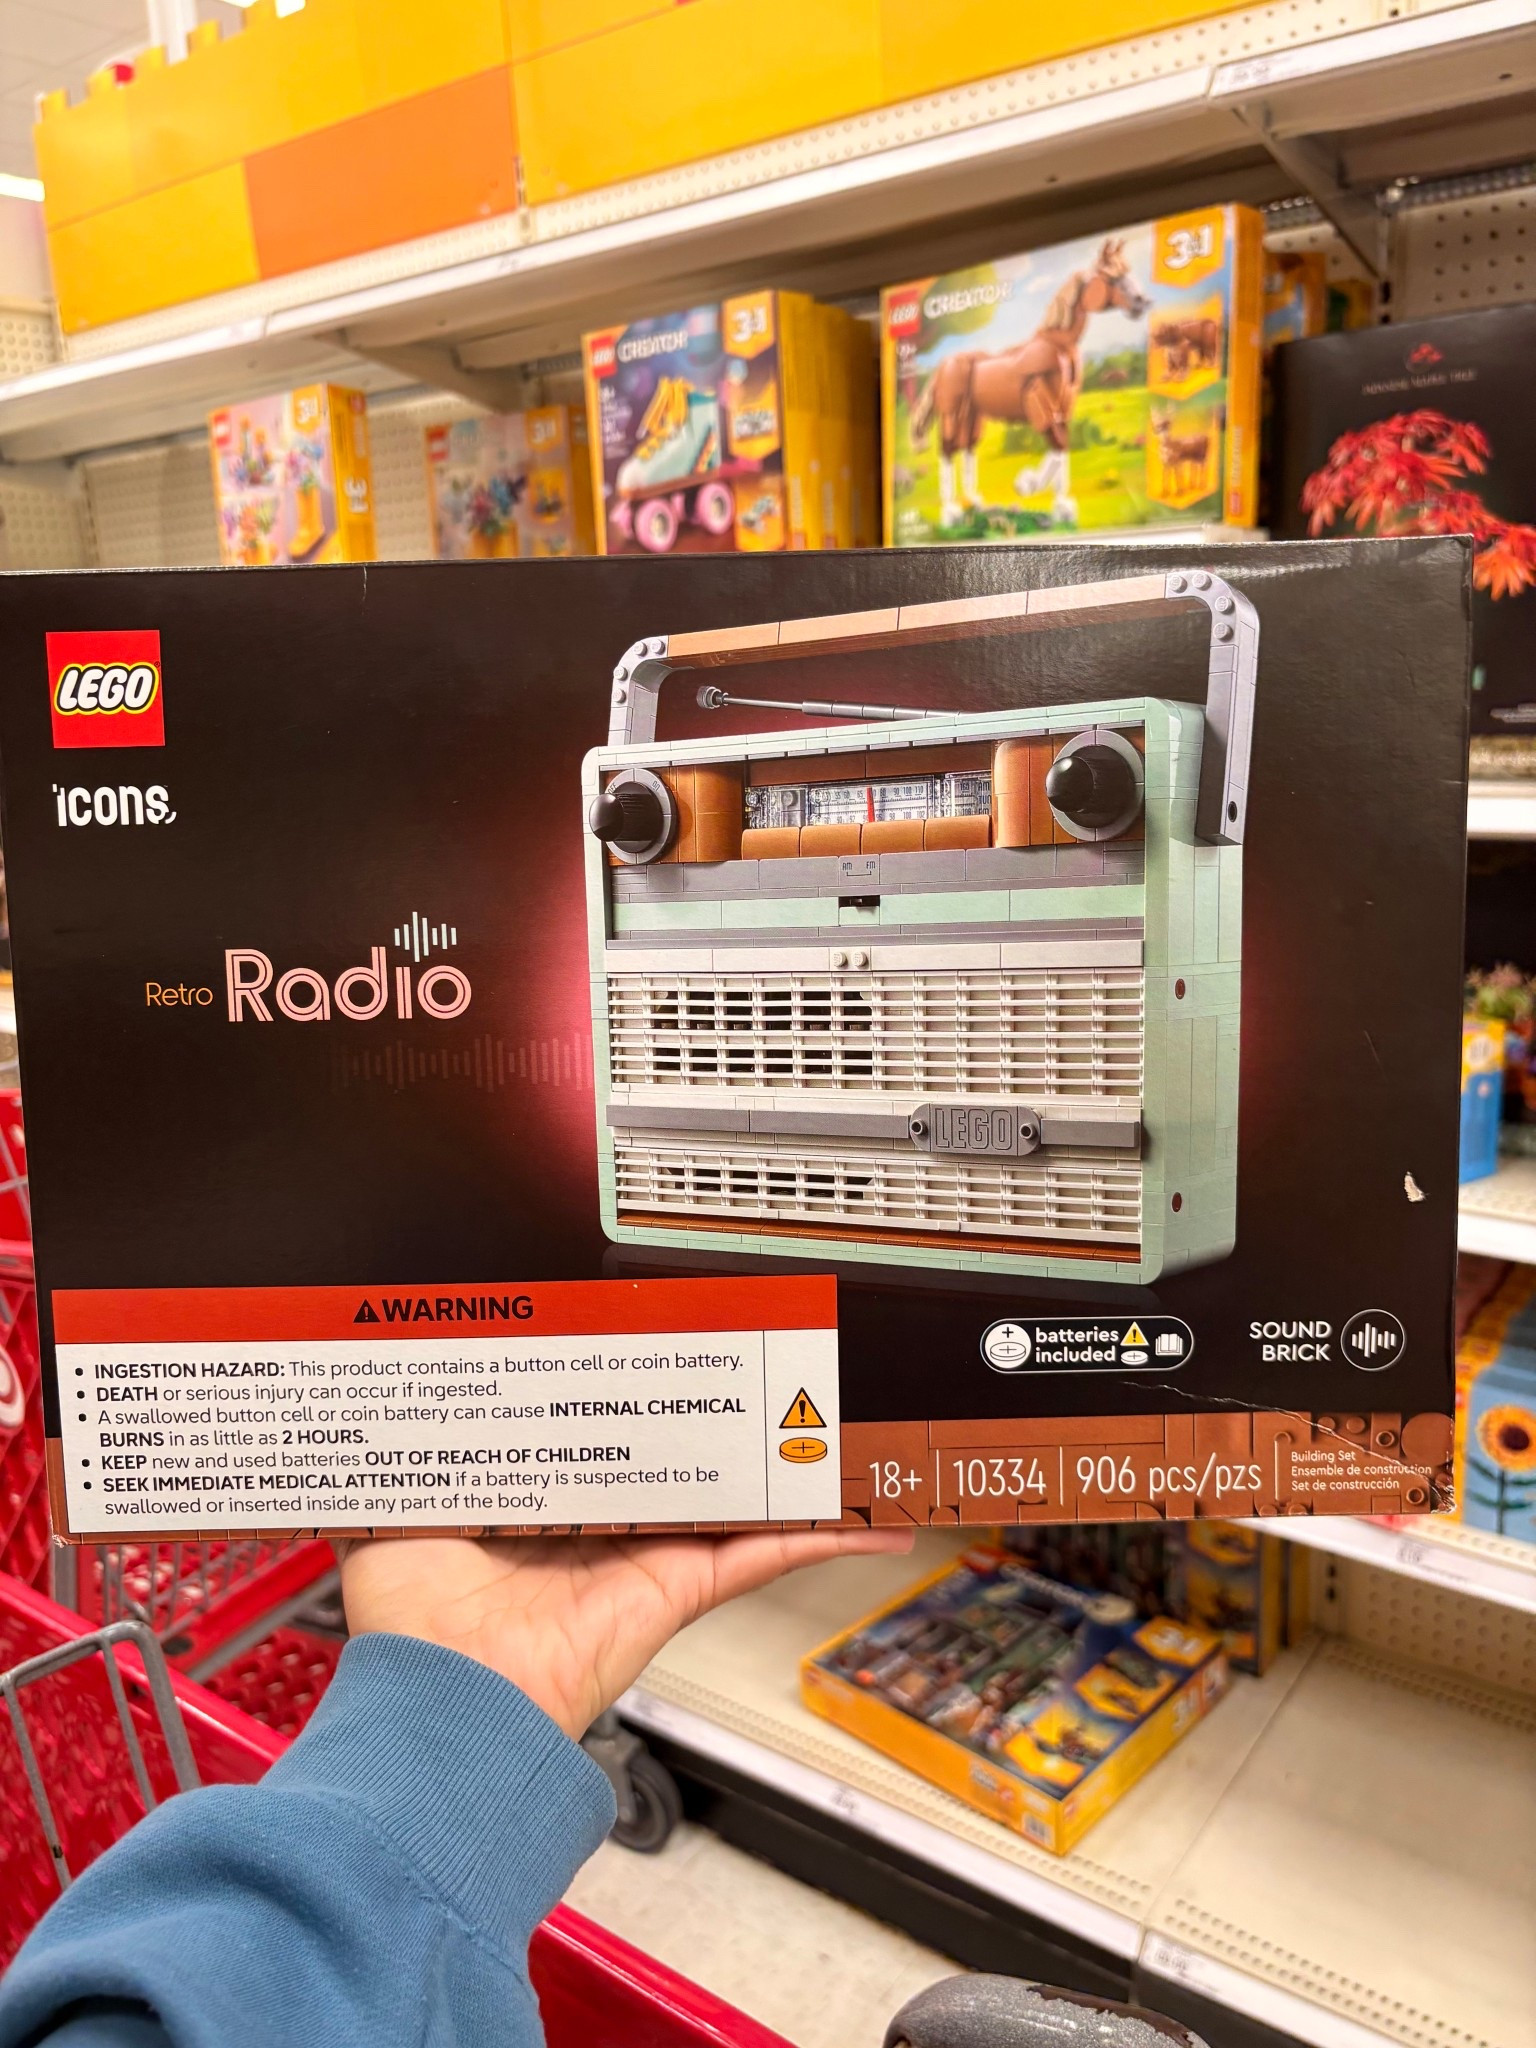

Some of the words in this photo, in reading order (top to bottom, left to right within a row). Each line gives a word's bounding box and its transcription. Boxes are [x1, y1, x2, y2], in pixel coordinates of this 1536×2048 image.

[55, 664, 157, 714] LEGO
[842, 862, 852, 871] AM
[866, 860, 876, 870] FM
[146, 983, 213, 1006] Retro
[225, 946, 472, 1022] Radio
[935, 1108, 1012, 1150] LEGO
[382, 1296, 534, 1322] WARNING
[1035, 1325, 1119, 1343] batteries
[1250, 1321, 1332, 1339] SOUND
[1035, 1345, 1116, 1363] included
[1262, 1343, 1331, 1361] BRICK
[95, 1363, 196, 1378] INGESTION
[202, 1362, 284, 1377] HAZARD:
[289, 1361, 325, 1376] This
[331, 1360, 402, 1380] product
[408, 1358, 484, 1374] contains
[490, 1362, 499, 1372] a
[505, 1357, 564, 1372] button
[571, 1355, 604, 1370] cell
[609, 1358, 626, 1370] or
[632, 1354, 669, 1369] coin
[676, 1353, 743, 1370] battery.
[97, 1387, 158, 1401] DEATH
[164, 1390, 181, 1400] or
[186, 1385, 250, 1400] serious
[256, 1384, 304, 1403] injury
[310, 1388, 340, 1398] can
[347, 1387, 397, 1398] occur
[403, 1382, 413, 1397] if
[418, 1380, 501, 1401] ingested.
[98, 1410, 111, 1424] A
[116, 1408, 211, 1424] swallowed
[217, 1408, 275, 1423] button
[282, 1406, 314, 1422] cell
[318, 1410, 336, 1421] or
[342, 1406, 378, 1421] coin
[385, 1406, 448, 1423] battery
[454, 1408, 485, 1419] can
[492, 1406, 544, 1418] cause
[550, 1401, 644, 1417] INTERNAL
[648, 1398, 746, 1414] CHEMICAL
[100, 1432, 164, 1447] BURNS
[169, 1431, 184, 1446] in
[190, 1435, 208, 1446] as
[214, 1430, 253, 1445] little
[259, 1434, 277, 1444] as
[283, 1430, 292, 1444] 2
[298, 1429, 368, 1444] HOURS.
[102, 1455, 147, 1470] KEEP
[153, 1458, 189, 1468] new
[195, 1453, 228, 1468] and
[234, 1452, 276, 1467] used
[282, 1451, 360, 1466] batteries
[366, 1451, 404, 1465] OUT
[409, 1451, 433, 1465] OF
[438, 1450, 501, 1464] REACH
[507, 1449, 531, 1463] OF
[536, 1447, 630, 1462] CHILDREN
[1291, 1451, 1335, 1464] Building
[1338, 1450, 1356, 1461] Set
[104, 1478, 149, 1492] SEEK
[153, 1476, 254, 1491] IMMEDIATE
[260, 1474, 342, 1489] MEDICAL
[345, 1473, 450, 1488] ATTENTION
[456, 1472, 466, 1486] if
[472, 1476, 480, 1486] a
[487, 1471, 550, 1488] battery
[556, 1470, 568, 1484] is
[574, 1468, 667, 1487] suspected
[673, 1469, 690, 1482] to
[696, 1467, 718, 1482] be
[870, 1461, 922, 1498] 18+
[953, 1458, 1047, 1496] 10334
[1076, 1455, 1136, 1494] 906
[1149, 1452, 1262, 1500] pcs/pzs
[1291, 1464, 1344, 1477] Ensemble
[1350, 1464, 1361, 1475] de
[1364, 1463, 1432, 1475] construction
[1292, 1480, 1310, 1491] Set
[1312, 1479, 1326, 1490] de
[1329, 1477, 1400, 1490] construcción
[106, 1498, 200, 1514] swallowed
[207, 1502, 224, 1512] or
[229, 1496, 301, 1512] inserted
[307, 1495, 359, 1510] inside
[365, 1499, 396, 1513] any
[402, 1496, 436, 1512] part
[442, 1494, 459, 1508] of
[464, 1494, 492, 1508] the
[498, 1492, 547, 1511] body.
